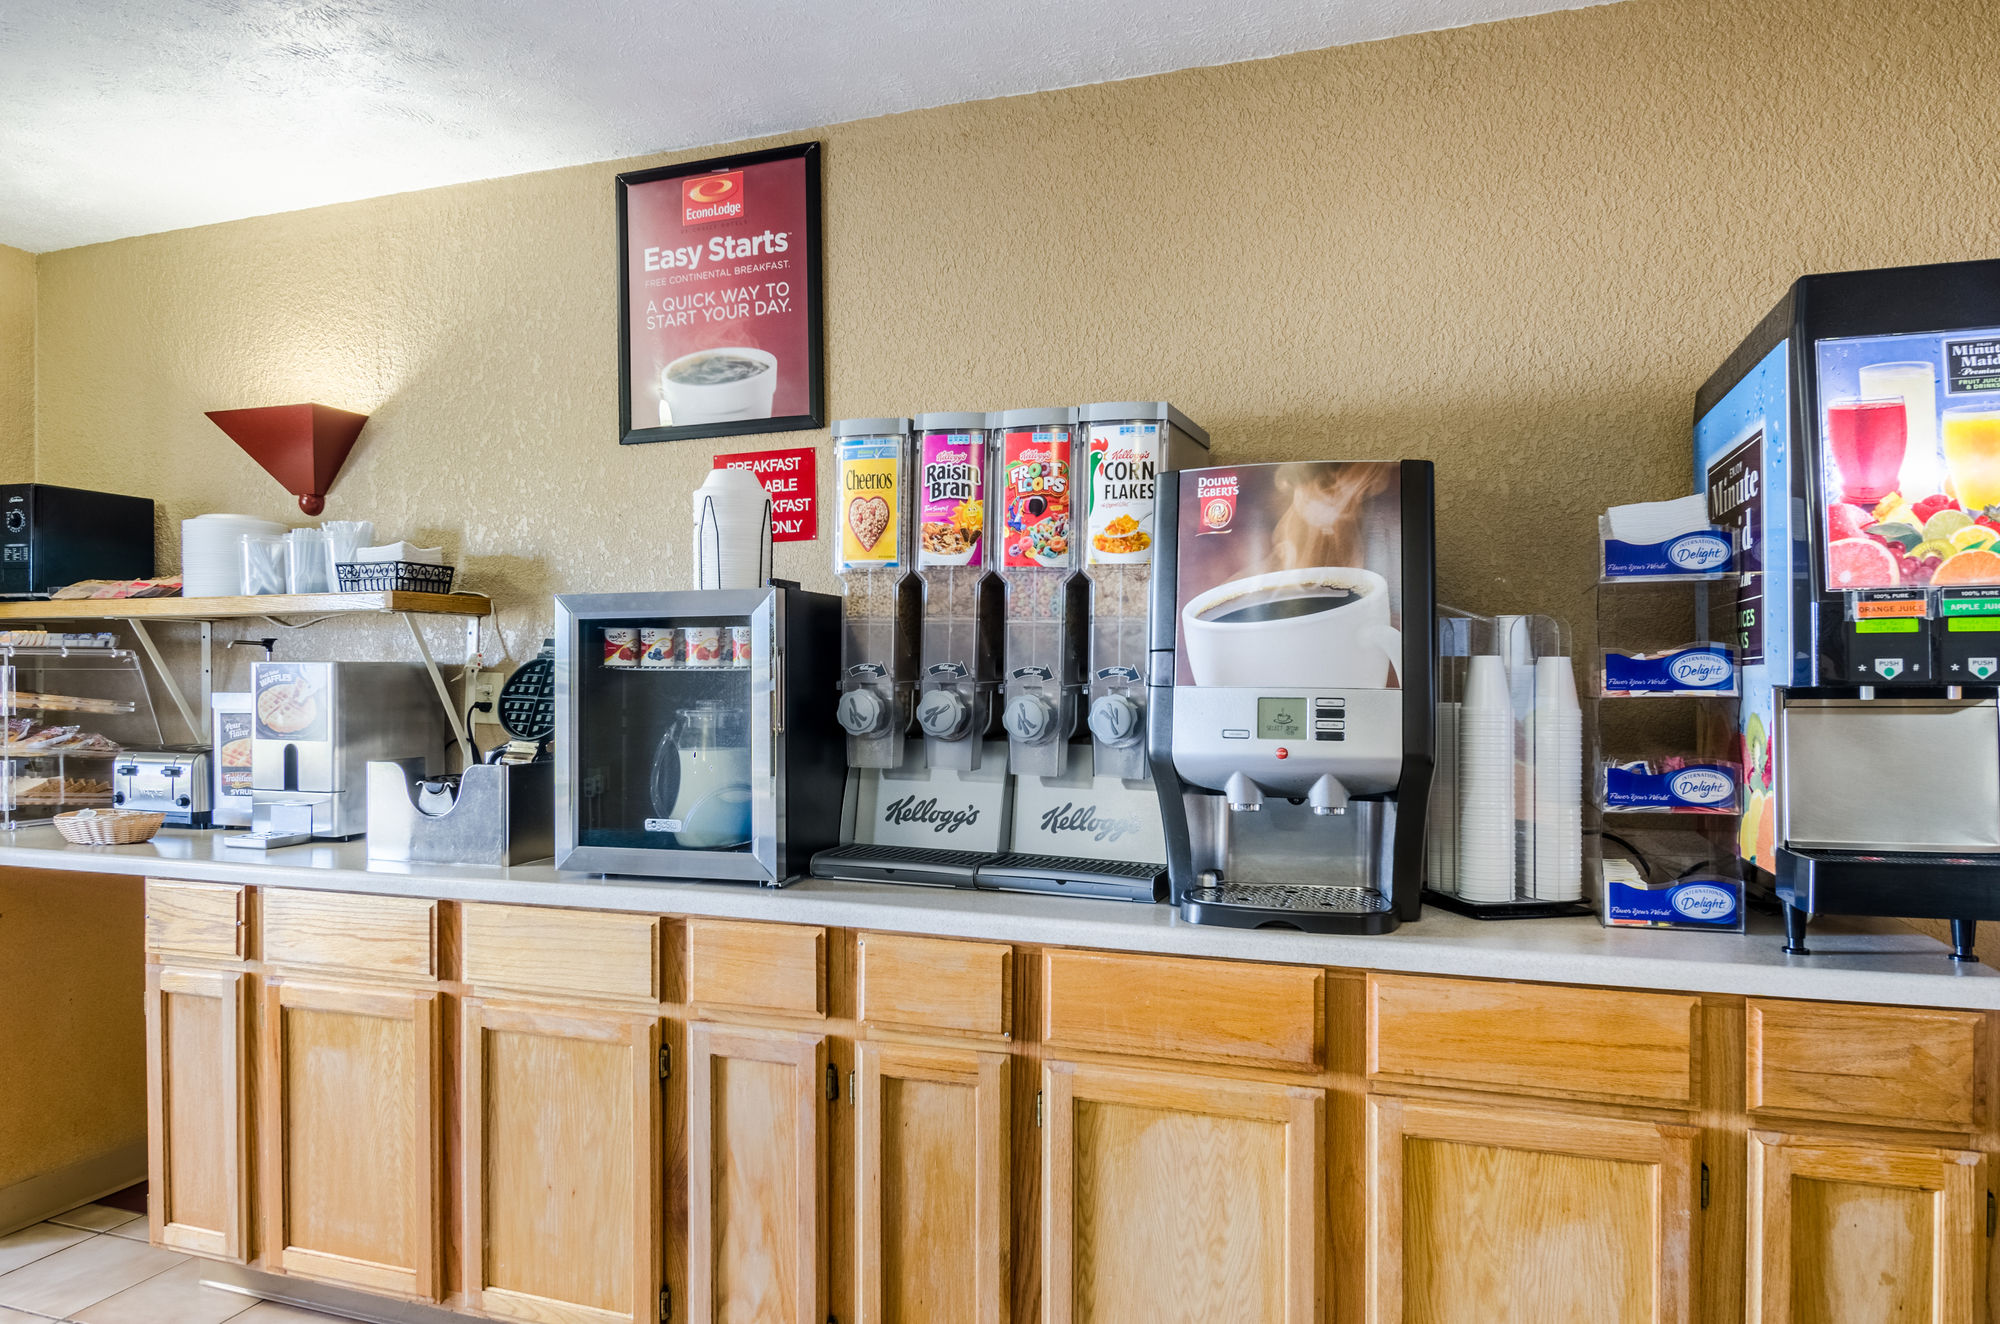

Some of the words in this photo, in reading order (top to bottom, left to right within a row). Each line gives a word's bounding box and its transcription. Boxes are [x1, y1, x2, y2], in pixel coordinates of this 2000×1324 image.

[686, 202, 741, 221] EconoLodge
[644, 244, 703, 272] Easy
[645, 278, 671, 289] FREE
[669, 269, 732, 285] CONTINENTAL
[734, 260, 791, 276] BREAKFAST.
[646, 300, 657, 314] A
[662, 291, 716, 312] QUICK
[720, 285, 760, 303] WAY
[765, 281, 790, 298] TO
[646, 310, 697, 330] START
[702, 303, 749, 322] YOUR
[755, 297, 792, 316] DAY.
[1952, 344, 2000, 356] Minut
[846, 469, 893, 491] Cheerios
[925, 463, 981, 486] Raisin
[1011, 462, 1062, 484] FROOT
[1104, 461, 1154, 480] CORN
[764, 478, 798, 493] ABLE
[930, 481, 973, 502] Bran
[1018, 476, 1066, 494] LOOPS
[1105, 484, 1154, 499] FLAKES
[1711, 467, 1759, 520] Minute
[772, 498, 811, 513] KFAST
[772, 519, 803, 534] ONLY
[1677, 547, 1722, 564] Delight
[1951, 603, 1980, 611] APPLE
[1678, 664, 1723, 681] Delight
[1680, 780, 1725, 798] Delight
[884, 794, 980, 833] Kellogg's
[1681, 897, 1726, 914] Delight
